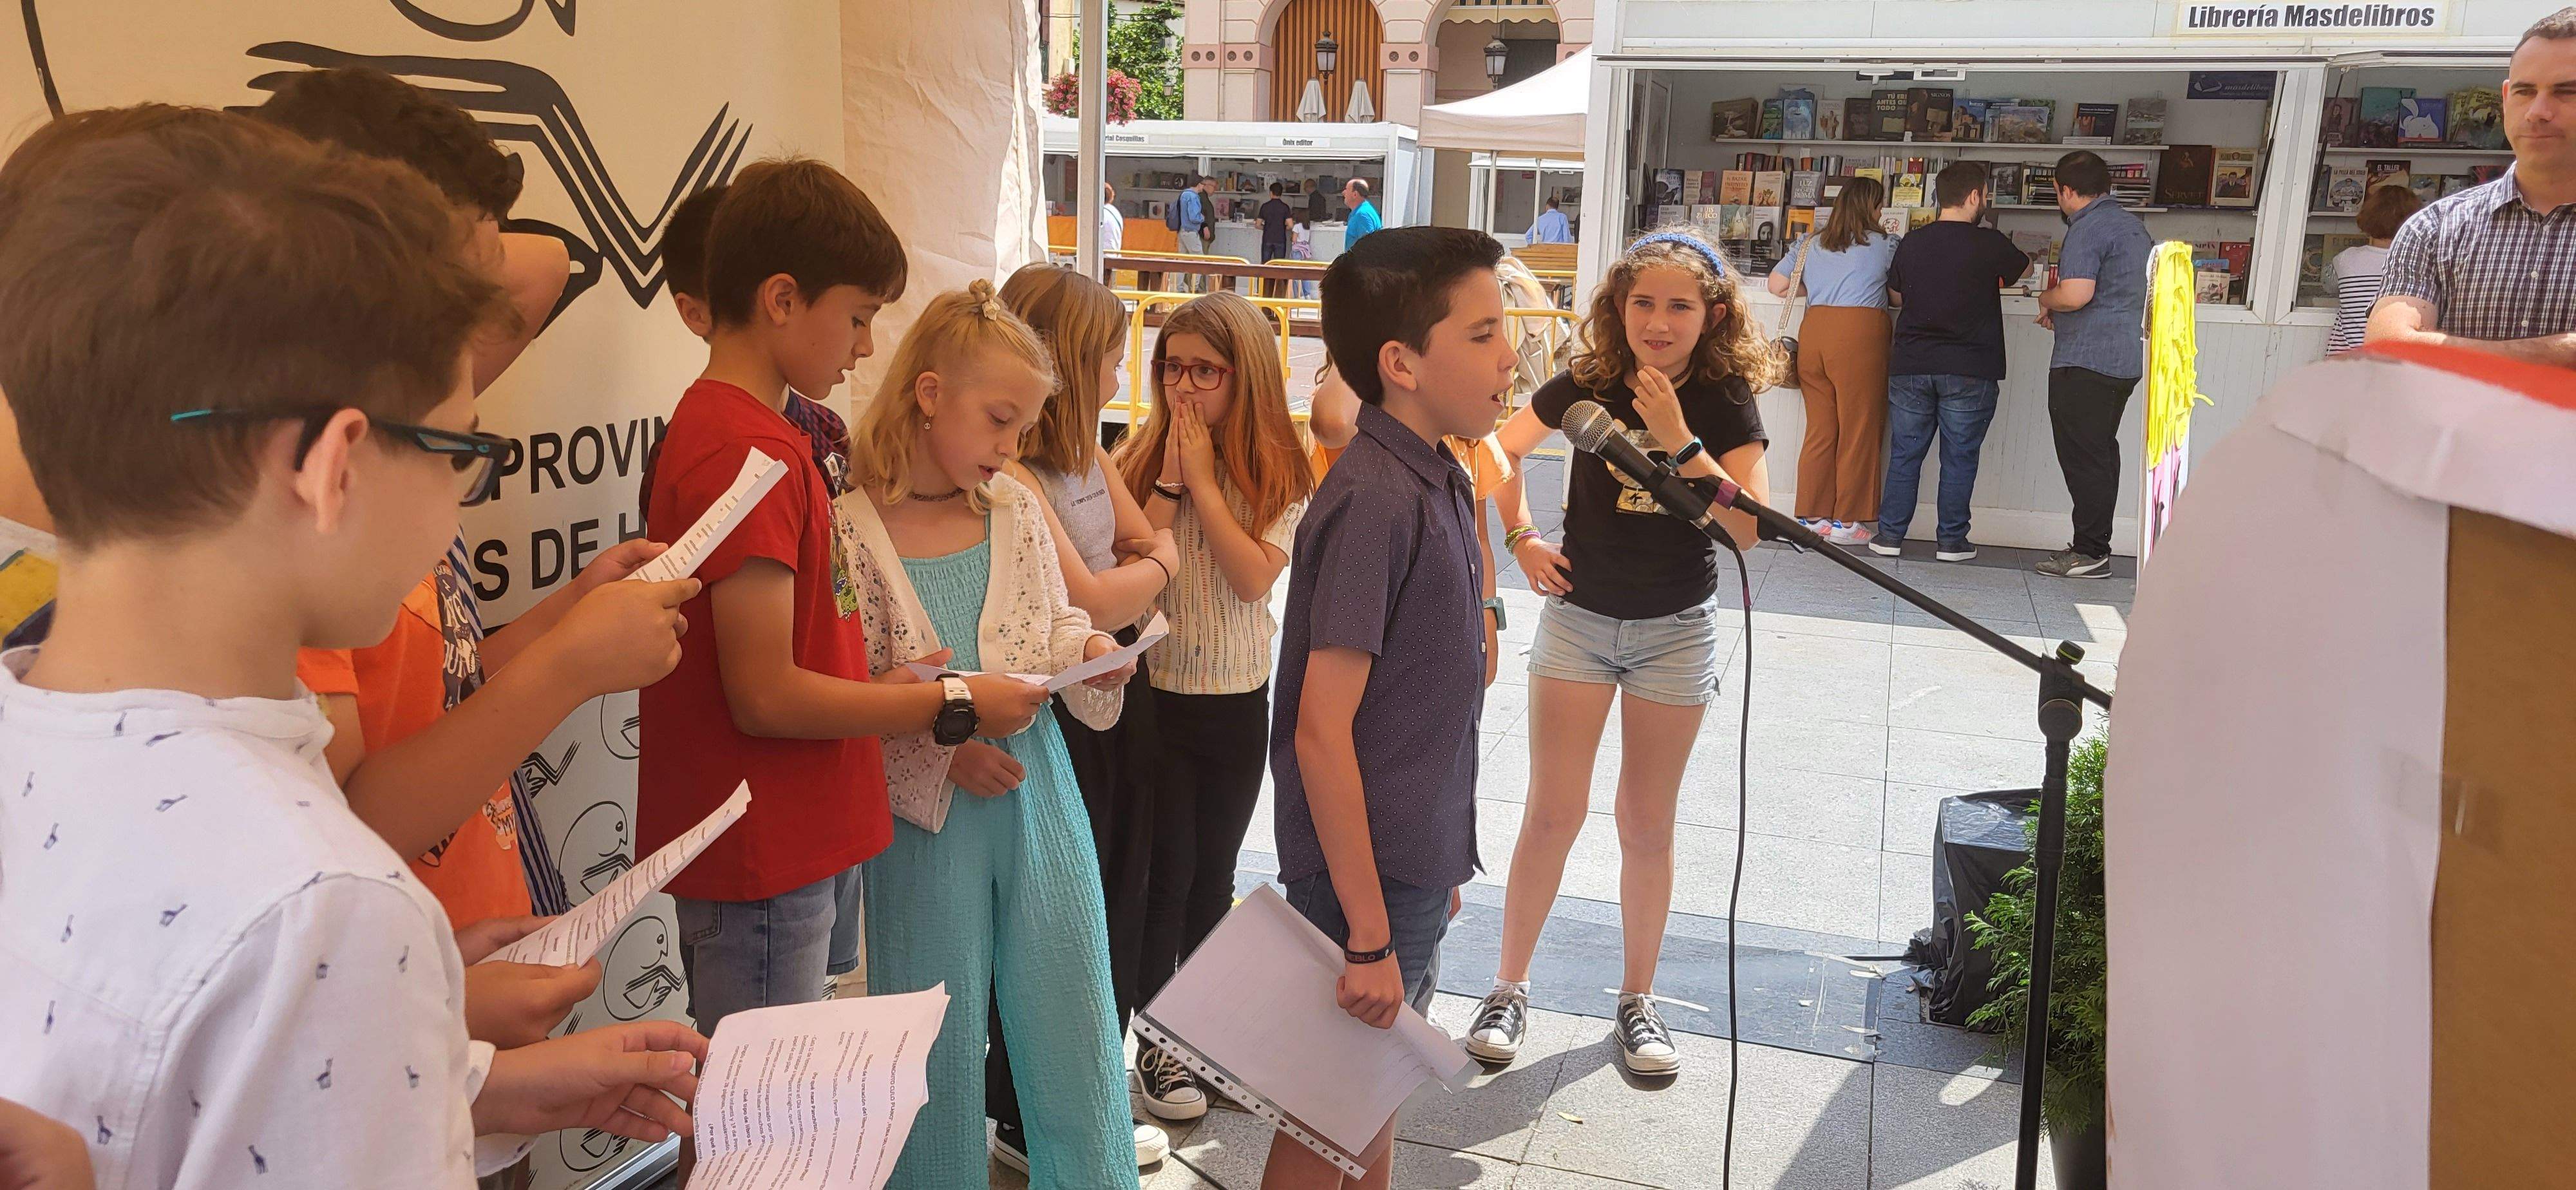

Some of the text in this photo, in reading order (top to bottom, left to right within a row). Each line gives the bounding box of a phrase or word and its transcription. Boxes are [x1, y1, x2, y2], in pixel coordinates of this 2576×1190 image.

[2188, 4, 2435, 28] Librería Masdelibros
[531, 518, 600, 590] DE
